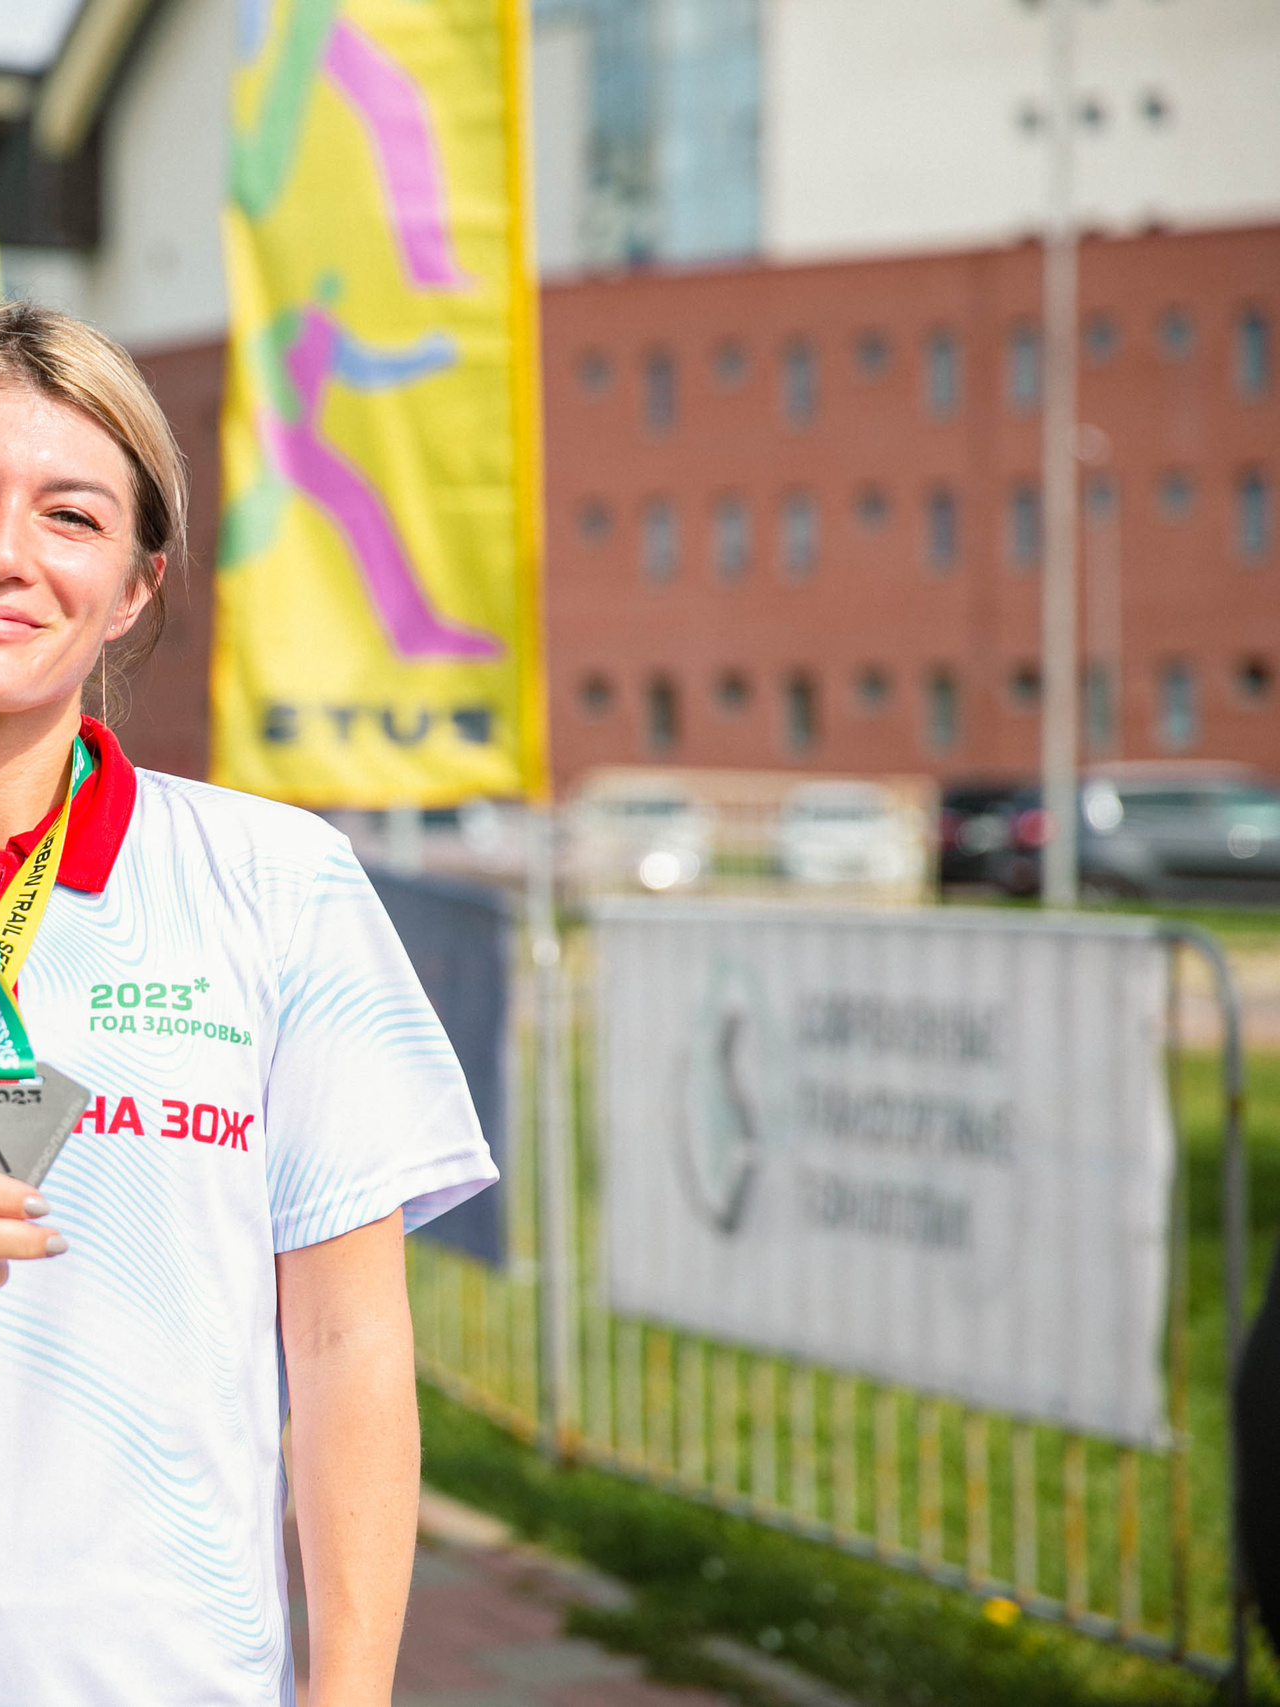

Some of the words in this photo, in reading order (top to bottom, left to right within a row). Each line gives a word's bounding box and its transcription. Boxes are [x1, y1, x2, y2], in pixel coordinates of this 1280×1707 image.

[1, 890, 37, 937] TRAIL
[89, 1014, 136, 1034] ГОД
[142, 1015, 253, 1047] ЗДОРОВЬЯ
[71, 1095, 145, 1136] НА
[160, 1098, 255, 1152] ЗОЖ
